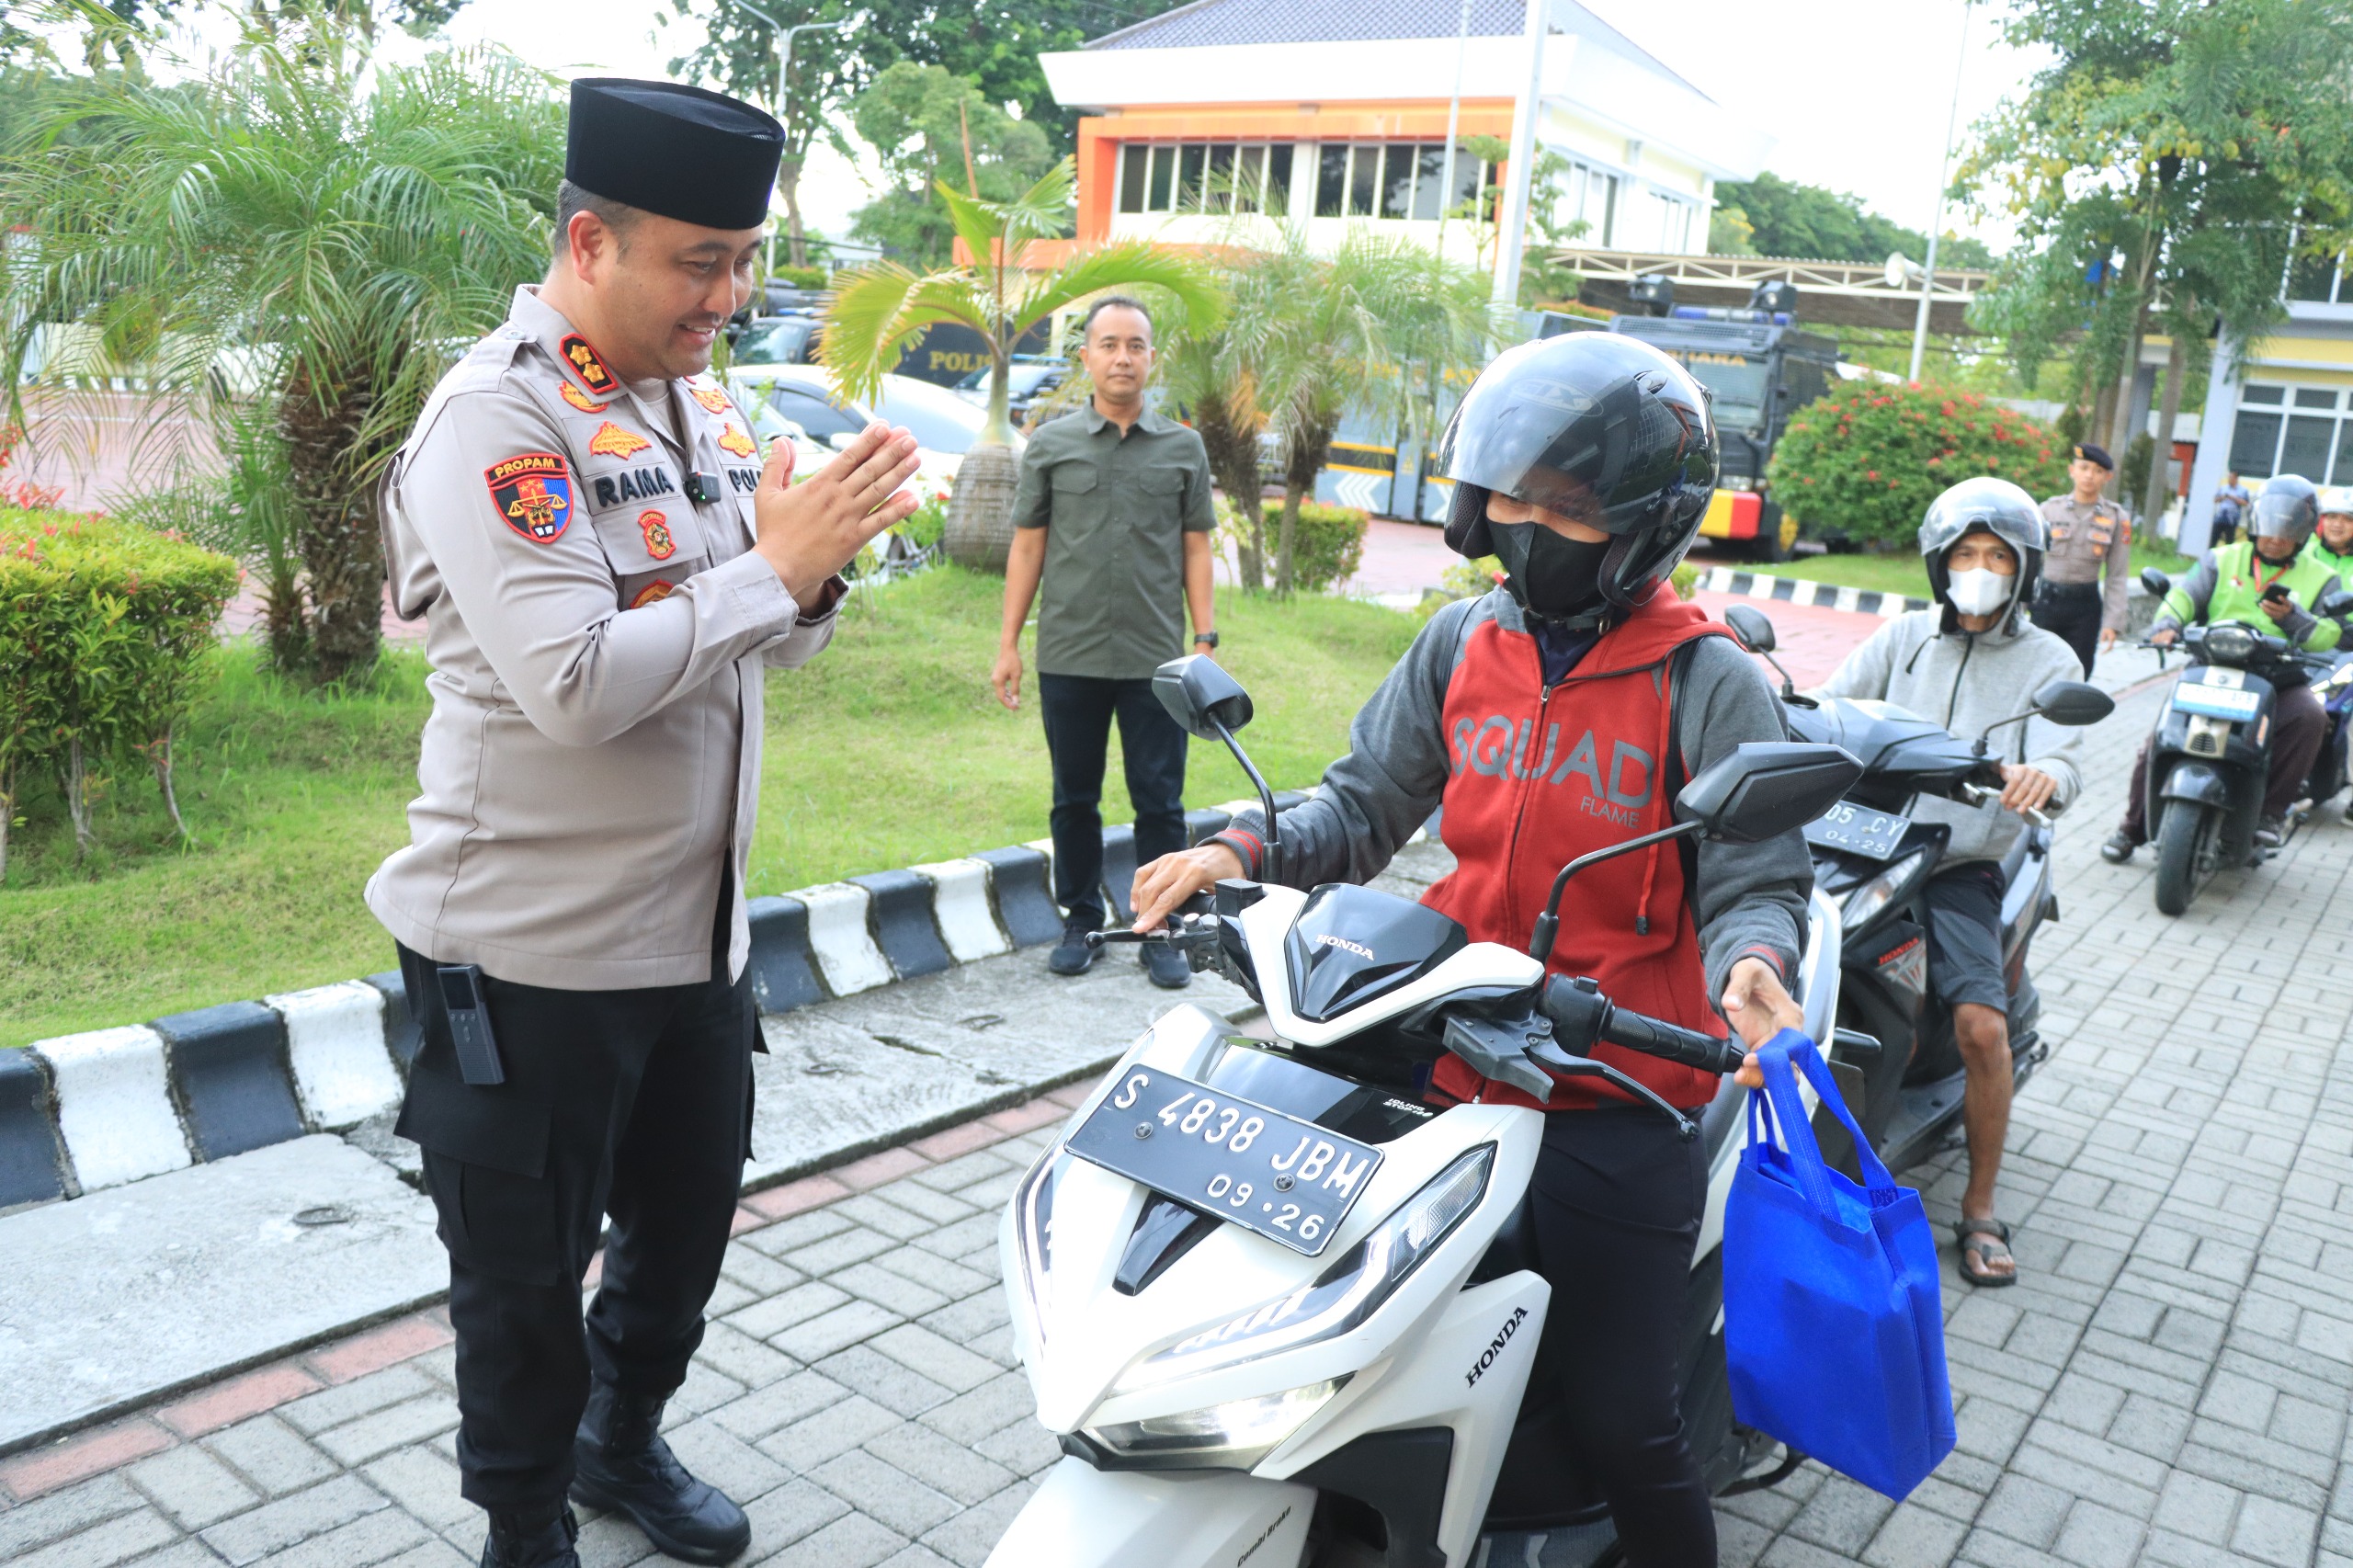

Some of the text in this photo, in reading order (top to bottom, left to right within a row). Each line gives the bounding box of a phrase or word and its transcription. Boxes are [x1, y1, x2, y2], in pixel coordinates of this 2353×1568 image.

[494, 457, 556, 478] PROPAM
[595, 466, 676, 507] RAMA
[1452, 714, 1654, 809] SQUAD
[1580, 795, 1641, 829] FLAME
[1870, 816, 1904, 837] CY
[1314, 934, 1375, 961] HONDA
[1878, 937, 1920, 966] HONDA
[1387, 1097, 1426, 1111] IDLING
[1114, 1074, 1370, 1199] S 4838 JBM
[1464, 1306, 1529, 1389] HONDA
[1237, 1506, 1291, 1568] Combi Brake
